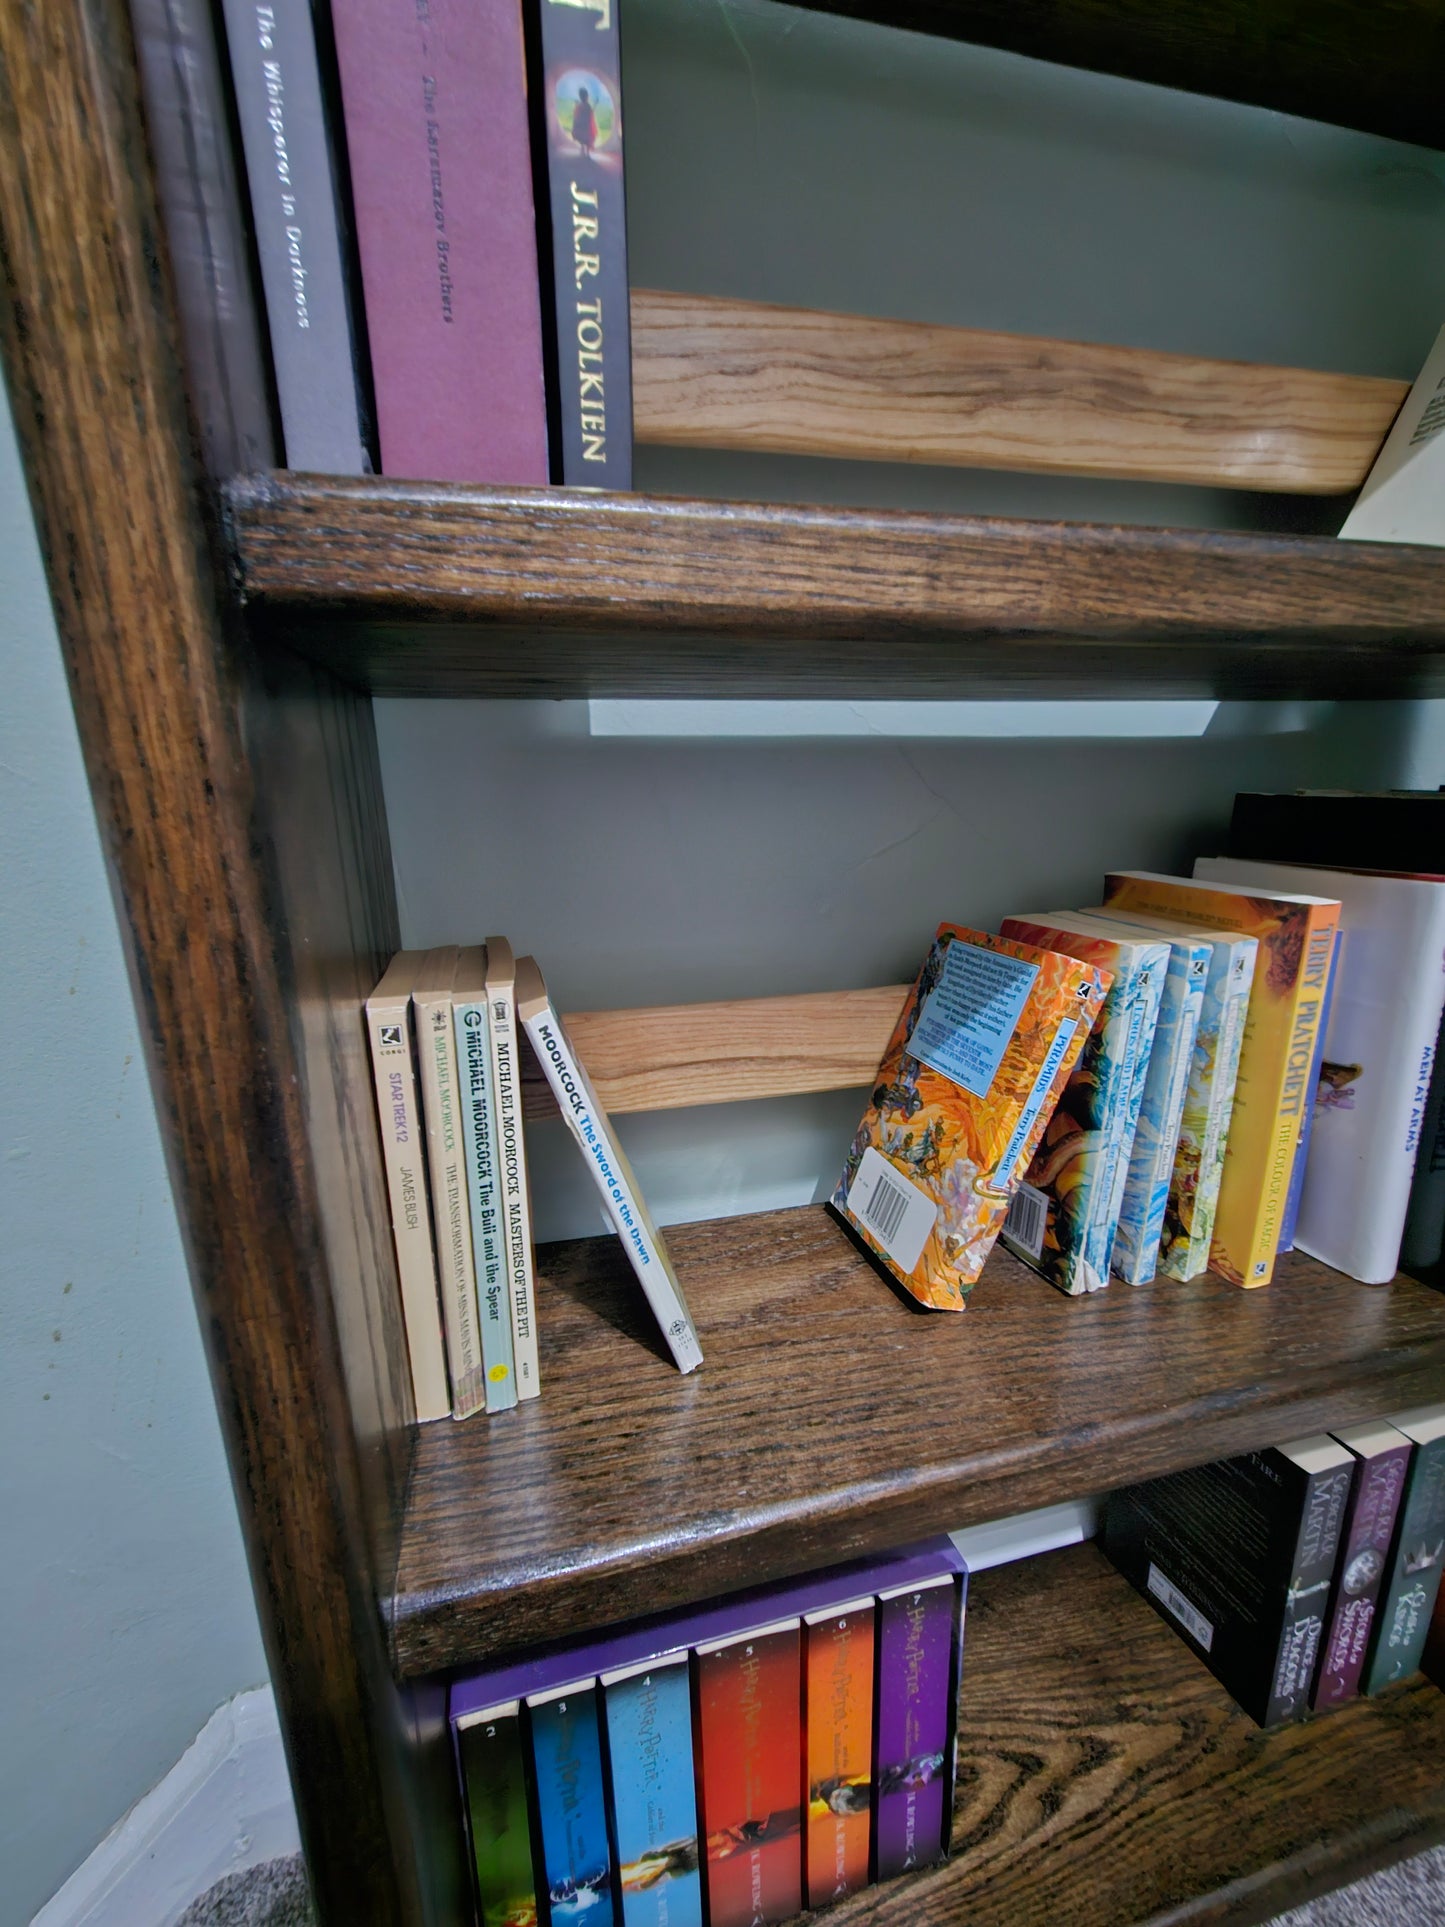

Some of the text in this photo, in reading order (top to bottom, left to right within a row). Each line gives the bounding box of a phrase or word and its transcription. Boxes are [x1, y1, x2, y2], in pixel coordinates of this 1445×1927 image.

[256, 5, 276, 50] The
[286, 225, 310, 329] Darkness
[437, 239, 454, 324] Brothers
[570, 180, 608, 465] J.R.R. TOLKIEN
[1303, 923, 1334, 989] TERRY
[434, 1036, 450, 1089] MICHAEL
[466, 1031, 486, 1096] MICHAEL
[496, 1041, 513, 1114] MICHAEL
[1280, 999, 1319, 1116] PRATCHETT
[388, 1072, 404, 1101] STAR
[1002, 1034, 1068, 1172] PYRAMIDS Terry Pratchett
[1404, 1046, 1432, 1152] MEN AT ARMS
[438, 1090, 455, 1152] MOORCOCK
[471, 1098, 493, 1179] MOORCOCK
[538, 1024, 651, 1266] MOORCOCK The Sword of the Dawn
[1279, 1121, 1292, 1140] THE
[400, 1166, 416, 1203] JAMES
[446, 1162, 458, 1186] THE
[502, 1115, 520, 1197] MOORCOCK
[1270, 1140, 1288, 1197] COLOUR
[405, 1203, 418, 1230] BLISH
[479, 1181, 494, 1206] The
[448, 1187, 466, 1279] TRANSFORMATION
[483, 1238, 499, 1261] and
[508, 1202, 525, 1269] MASTERS
[485, 1263, 501, 1284] the
[513, 1269, 526, 1287] OF
[514, 1287, 529, 1316] THE
[485, 1285, 501, 1322] Spear
[517, 1317, 530, 1339] PIT
[1301, 1475, 1334, 1568] MARTIN
[838, 1619, 847, 1630] 6
[558, 1702, 567, 1714] 3
[642, 1675, 651, 1686] 4
[486, 1725, 497, 1738] 2
[636, 1690, 662, 1788] HARRY POTTER
